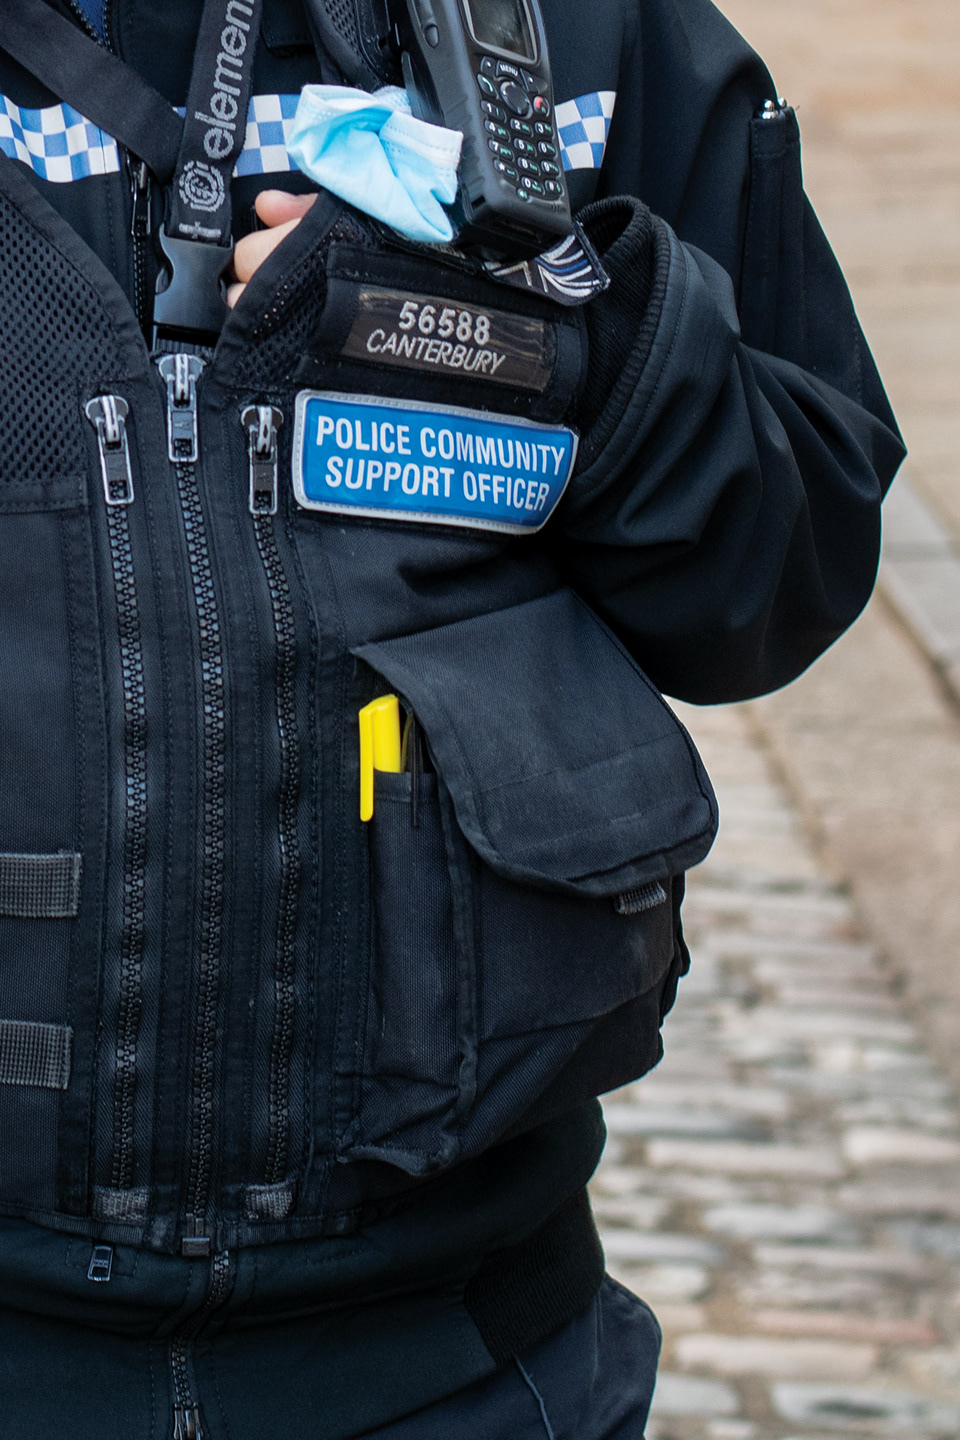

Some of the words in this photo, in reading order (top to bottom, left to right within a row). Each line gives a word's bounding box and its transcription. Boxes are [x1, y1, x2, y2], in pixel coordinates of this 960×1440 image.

[500, 64, 518, 76] MENU
[398, 301, 490, 345] 56588
[366, 329, 506, 374] CANTERBURY
[316, 415, 411, 455] POLICE
[420, 427, 565, 476] COMMUNITY
[325, 456, 454, 497] SUPPORT
[463, 471, 550, 511] OFFICER
